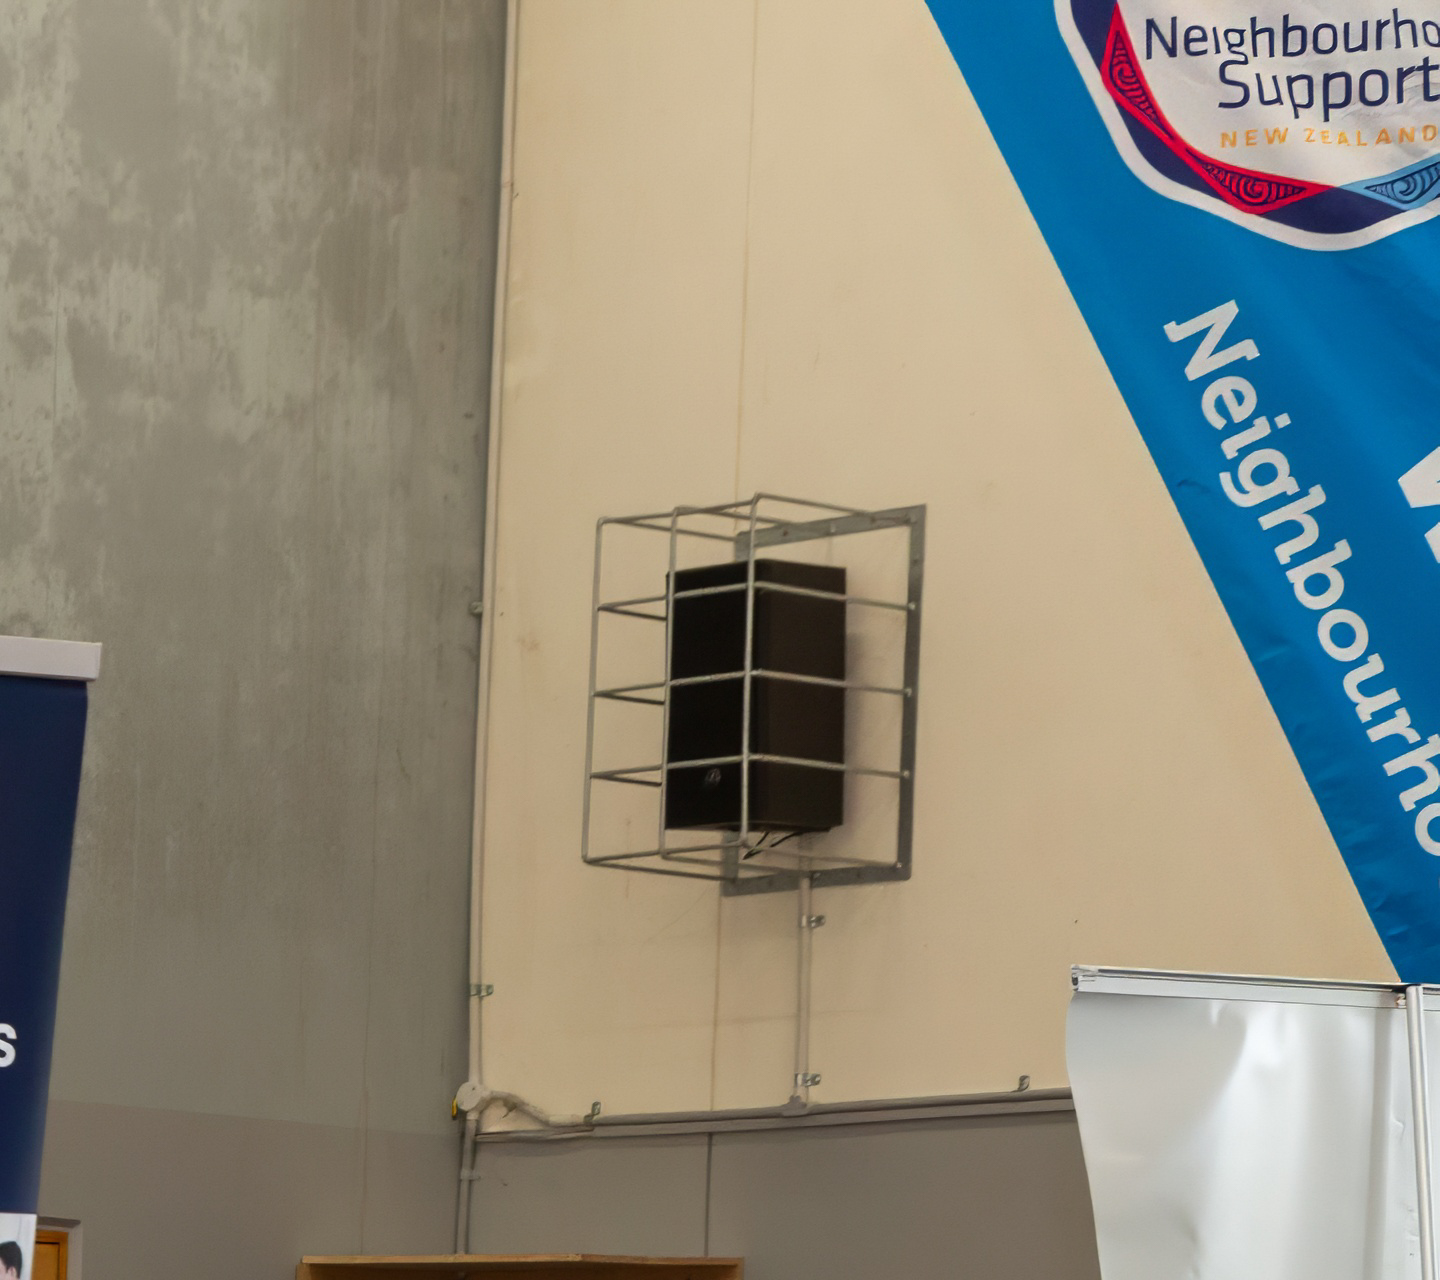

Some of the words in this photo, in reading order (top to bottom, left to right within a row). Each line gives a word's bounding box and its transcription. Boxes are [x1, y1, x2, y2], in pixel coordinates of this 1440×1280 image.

[1218, 57, 1440, 121] Support
[1221, 127, 1288, 149] NEW
[1305, 122, 1440, 148] ZEALAND
